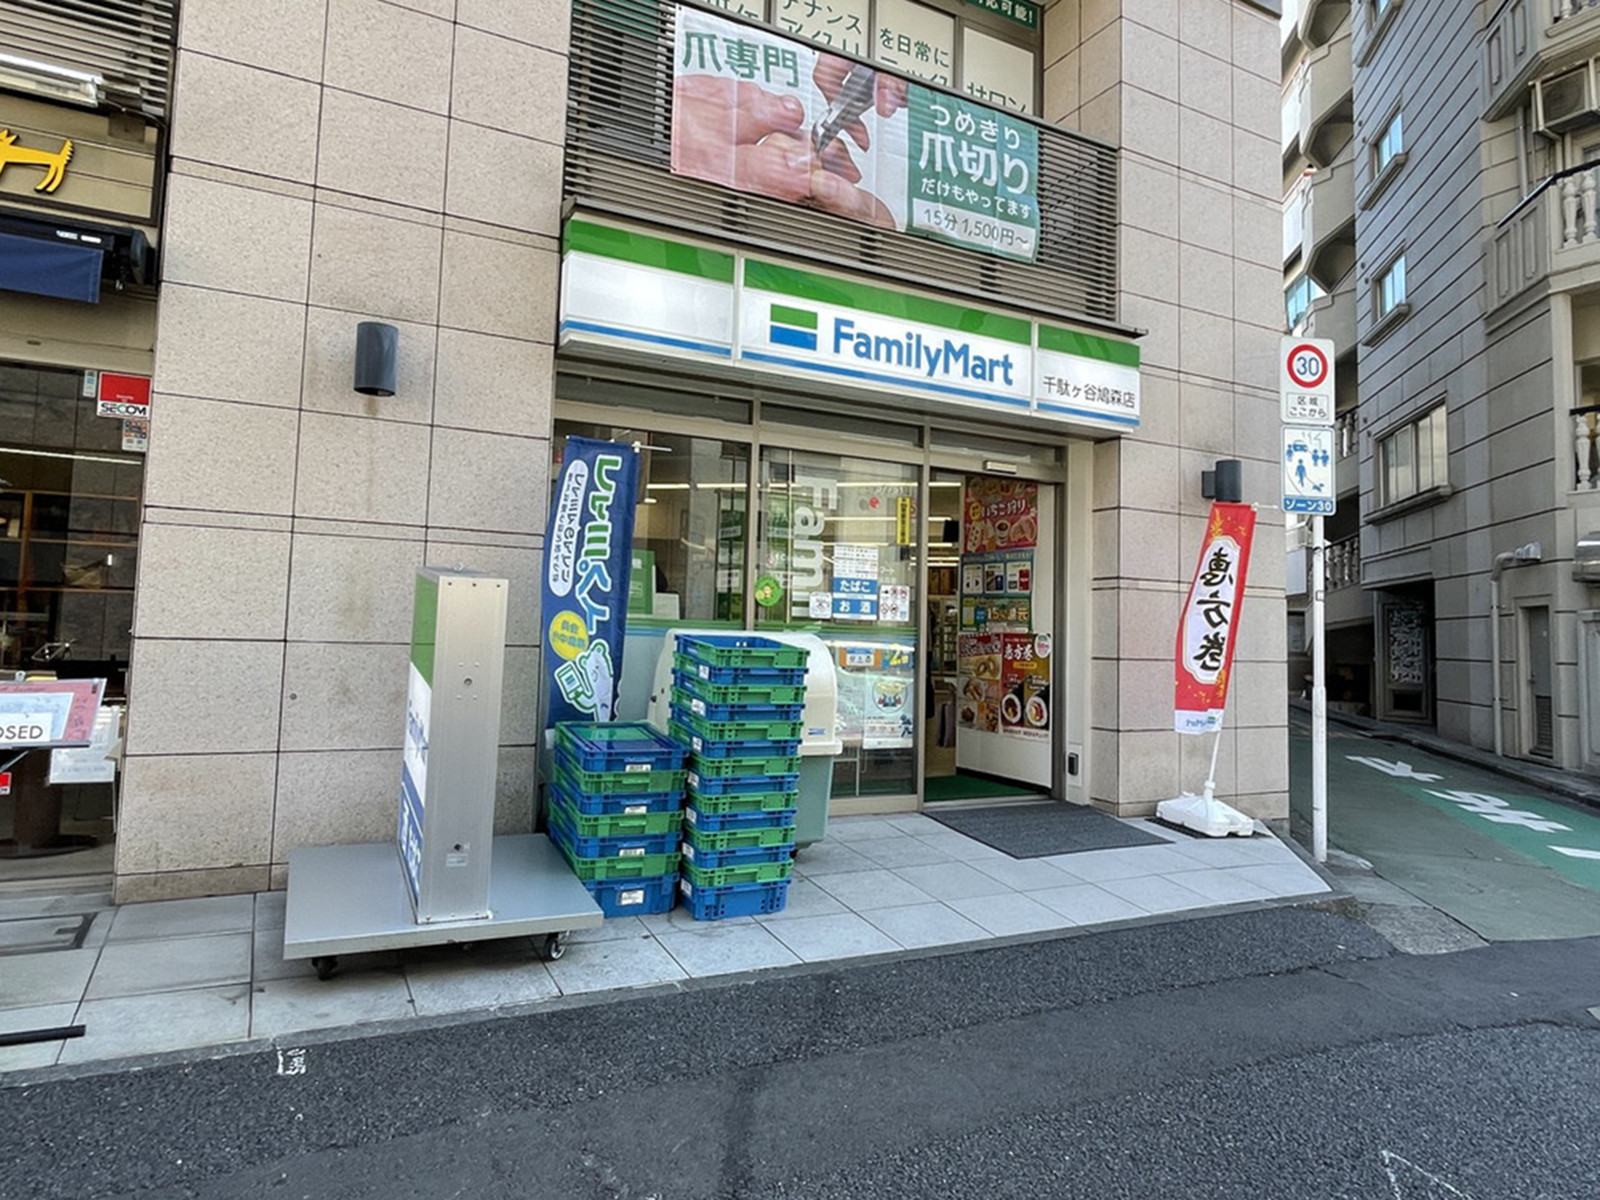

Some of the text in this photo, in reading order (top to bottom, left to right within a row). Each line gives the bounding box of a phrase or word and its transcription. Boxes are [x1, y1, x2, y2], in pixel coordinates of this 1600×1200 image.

[682, 31, 800, 88] 爪専門
[880, 28, 949, 68] を日常に
[930, 105, 1020, 149] つめきり
[919, 131, 1029, 194] 爪切り
[921, 178, 1031, 219] だけもやってます
[924, 208, 958, 231] 15分
[833, 317, 1013, 386] FamilyMart
[1296, 356, 1320, 377] 30
[101, 402, 147, 416] SECOM
[1289, 407, 1327, 418] ここから
[1286, 501, 1332, 512] ゾーン30
[840, 579, 871, 593] たばこ
